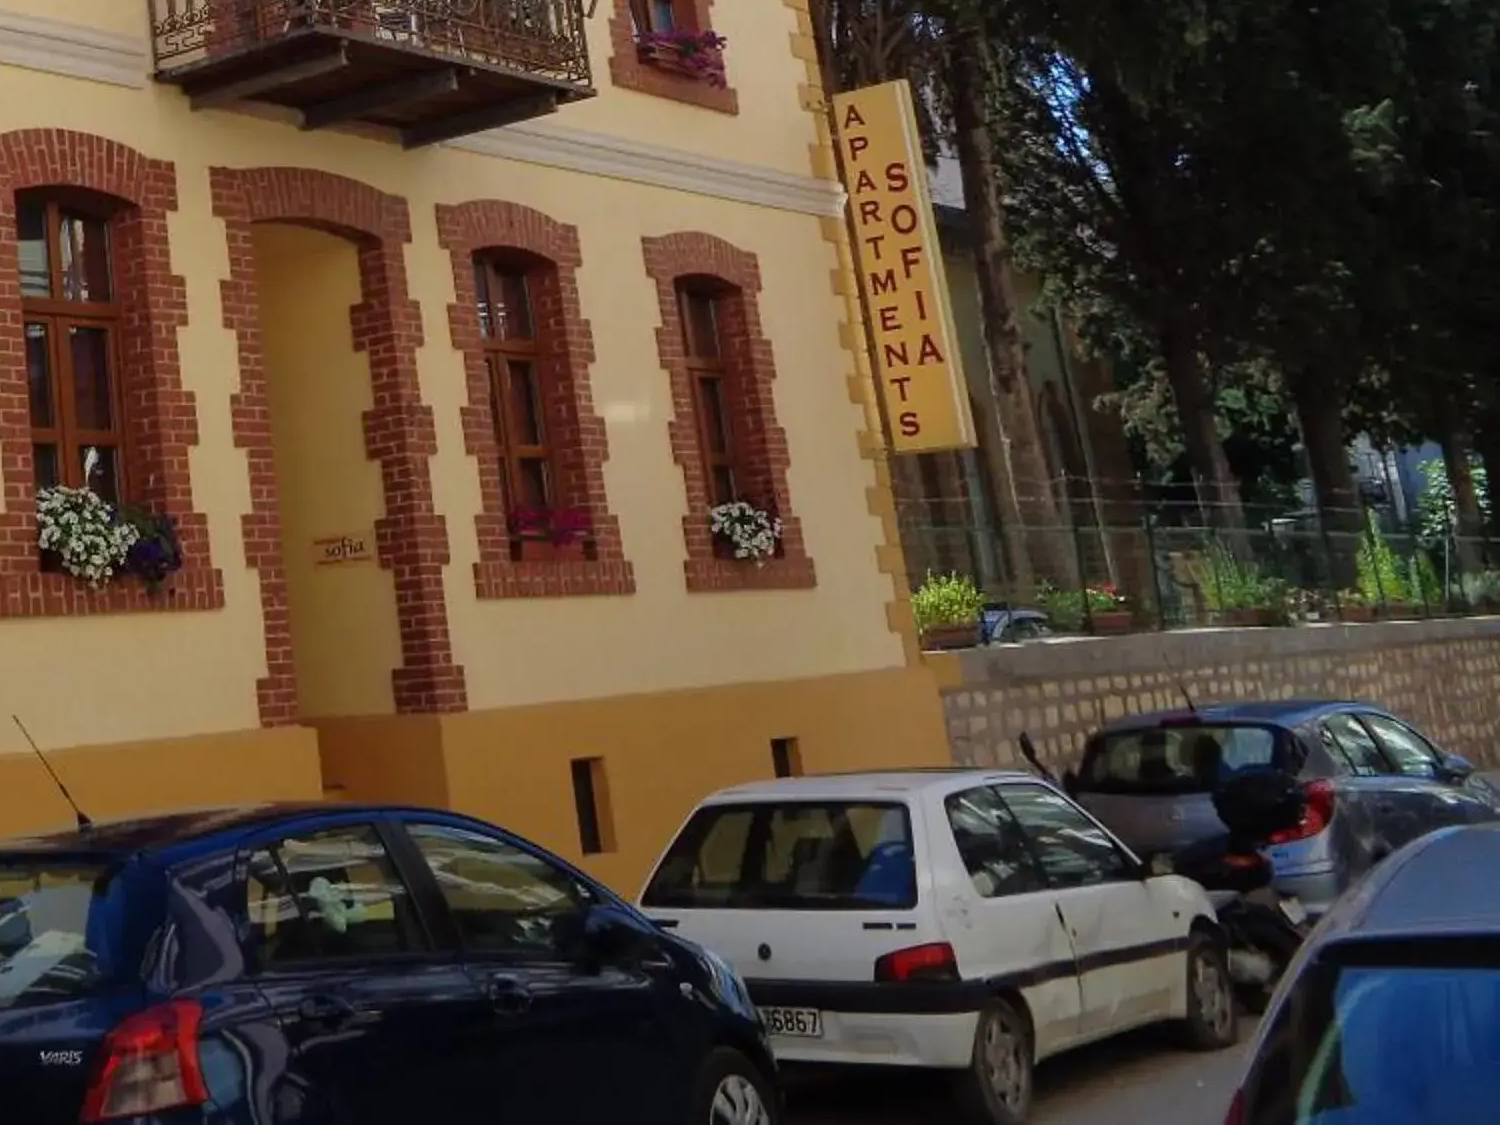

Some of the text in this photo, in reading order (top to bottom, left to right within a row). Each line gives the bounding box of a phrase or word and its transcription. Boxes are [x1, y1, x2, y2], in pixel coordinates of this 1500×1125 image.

[843, 104, 921, 437] APARTMENTS
[885, 162, 945, 366] SOFIA
[324, 535, 365, 559] sofia
